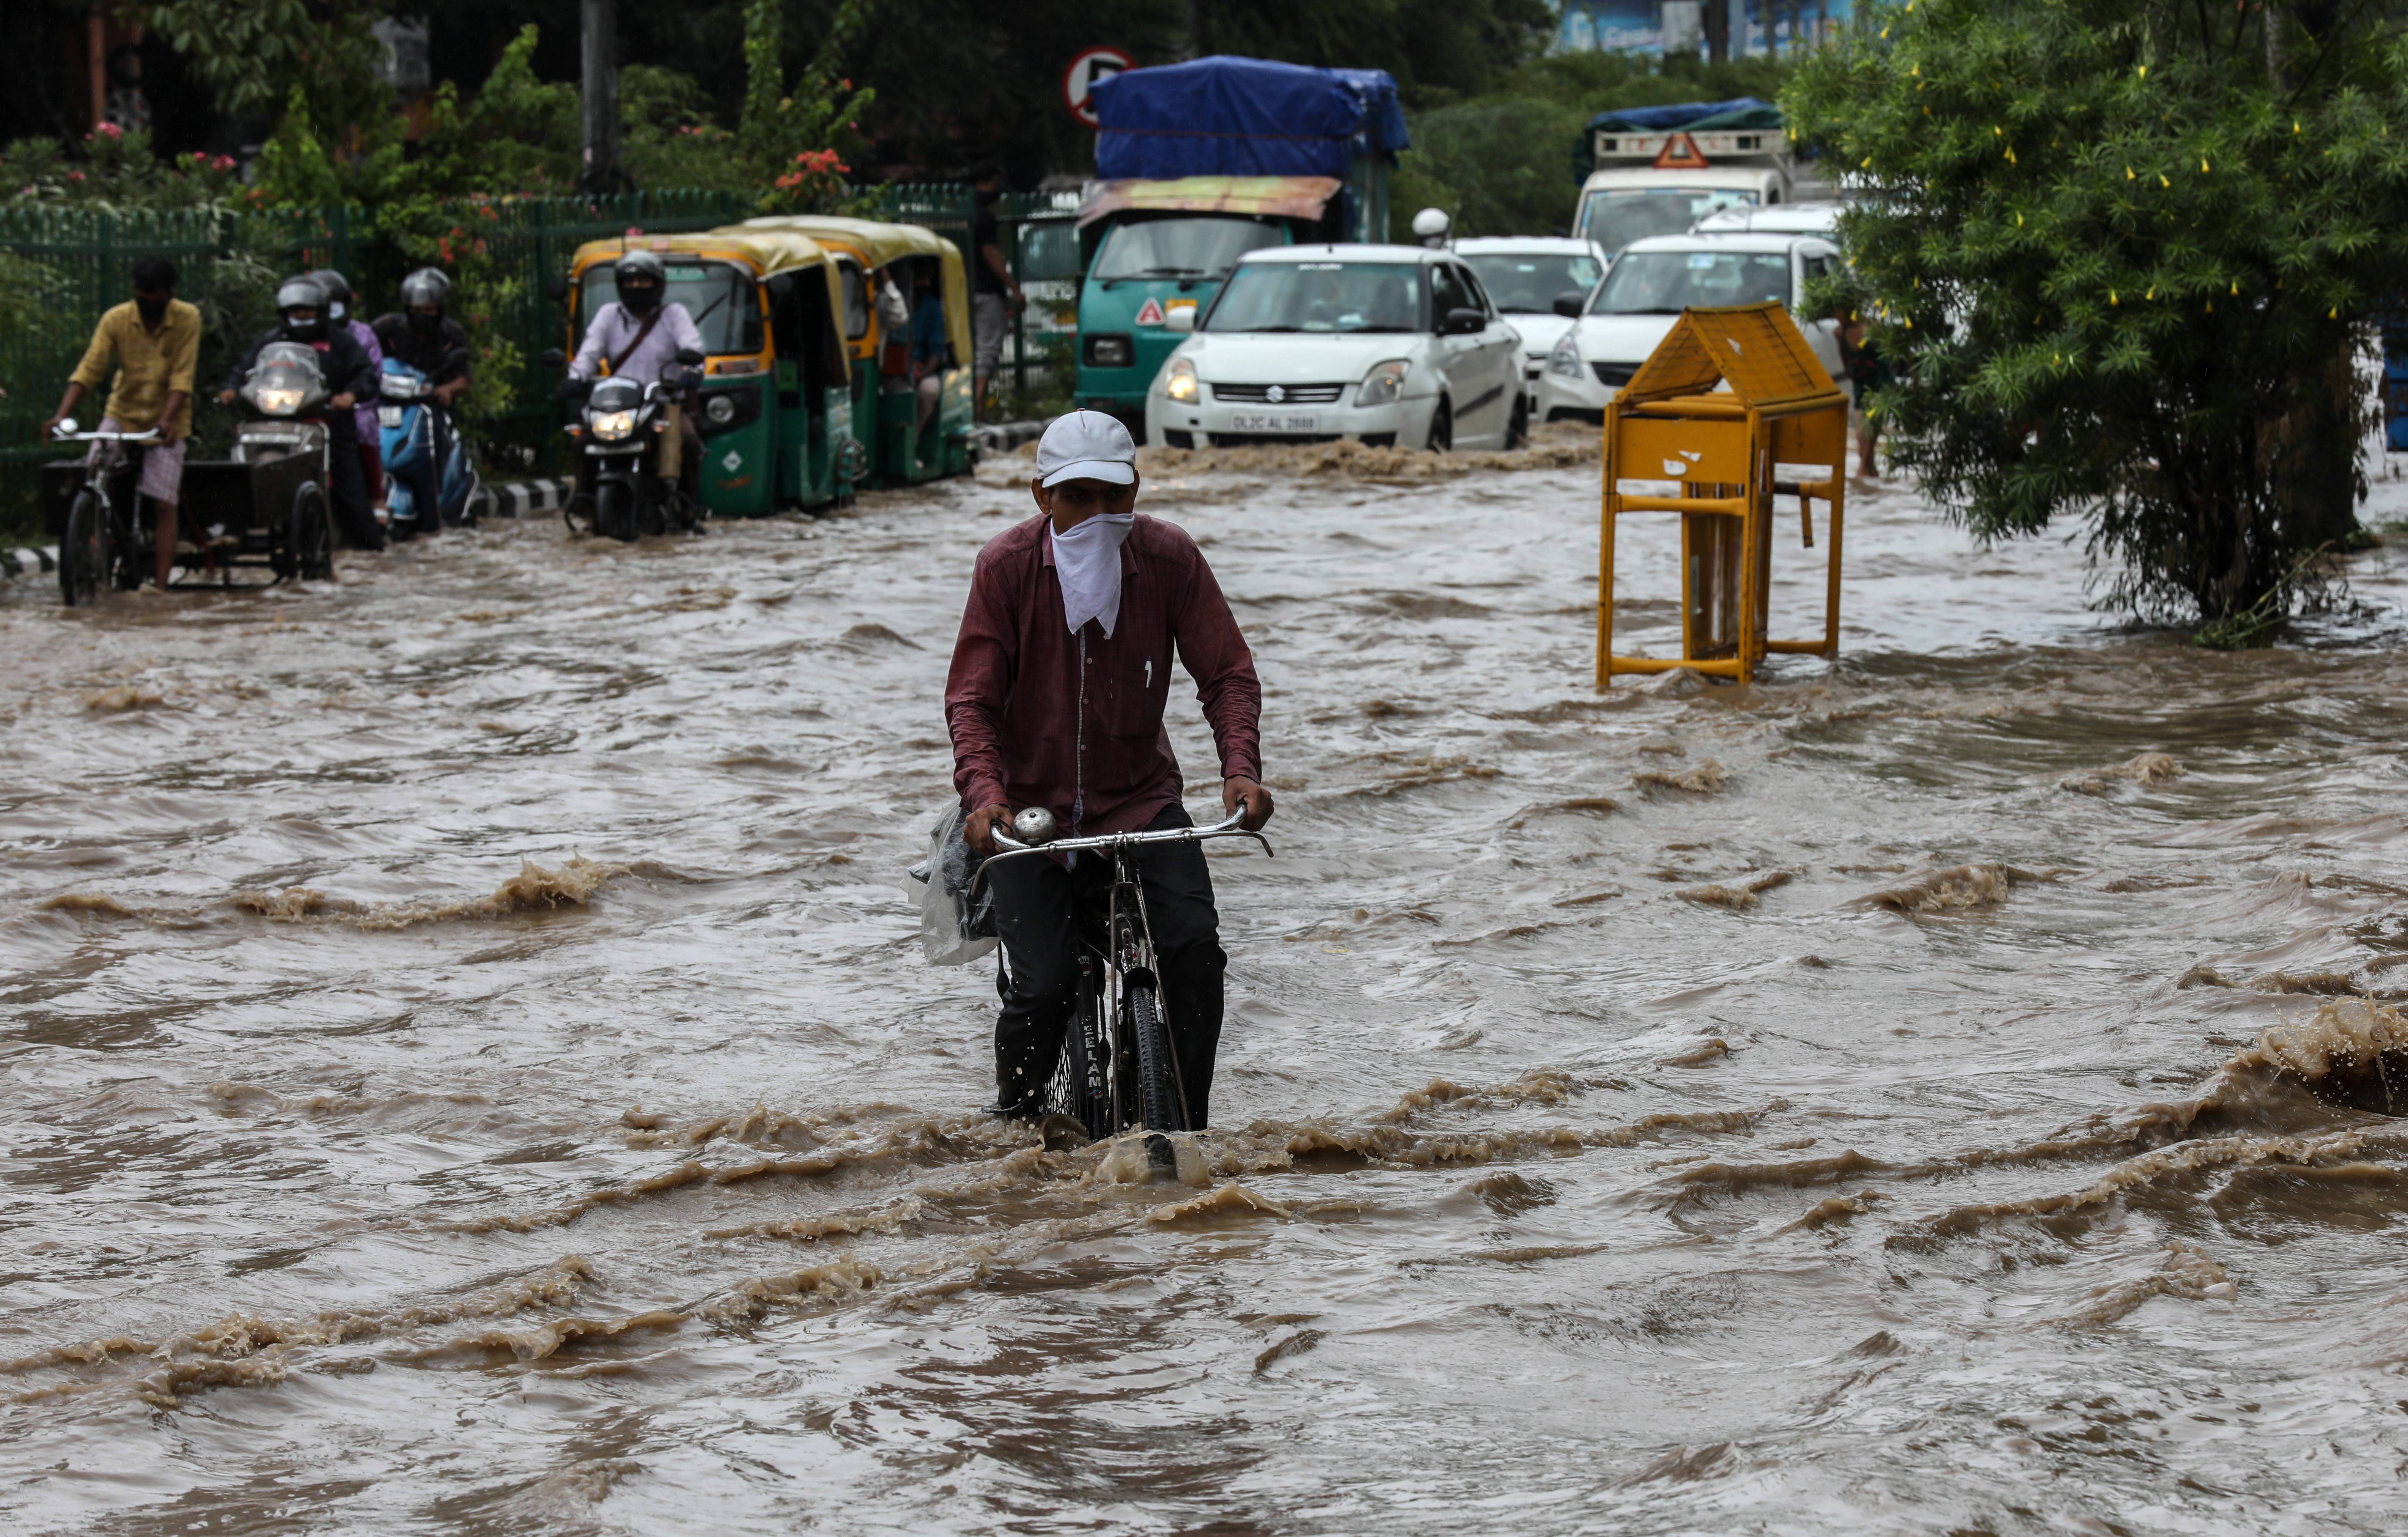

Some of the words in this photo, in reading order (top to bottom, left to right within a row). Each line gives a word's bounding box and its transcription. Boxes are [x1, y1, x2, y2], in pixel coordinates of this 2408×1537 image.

[1233, 416, 1265, 430] DL2C
[1268, 416, 1284, 430] AL
[1082, 1016, 1101, 1088] EELAM
